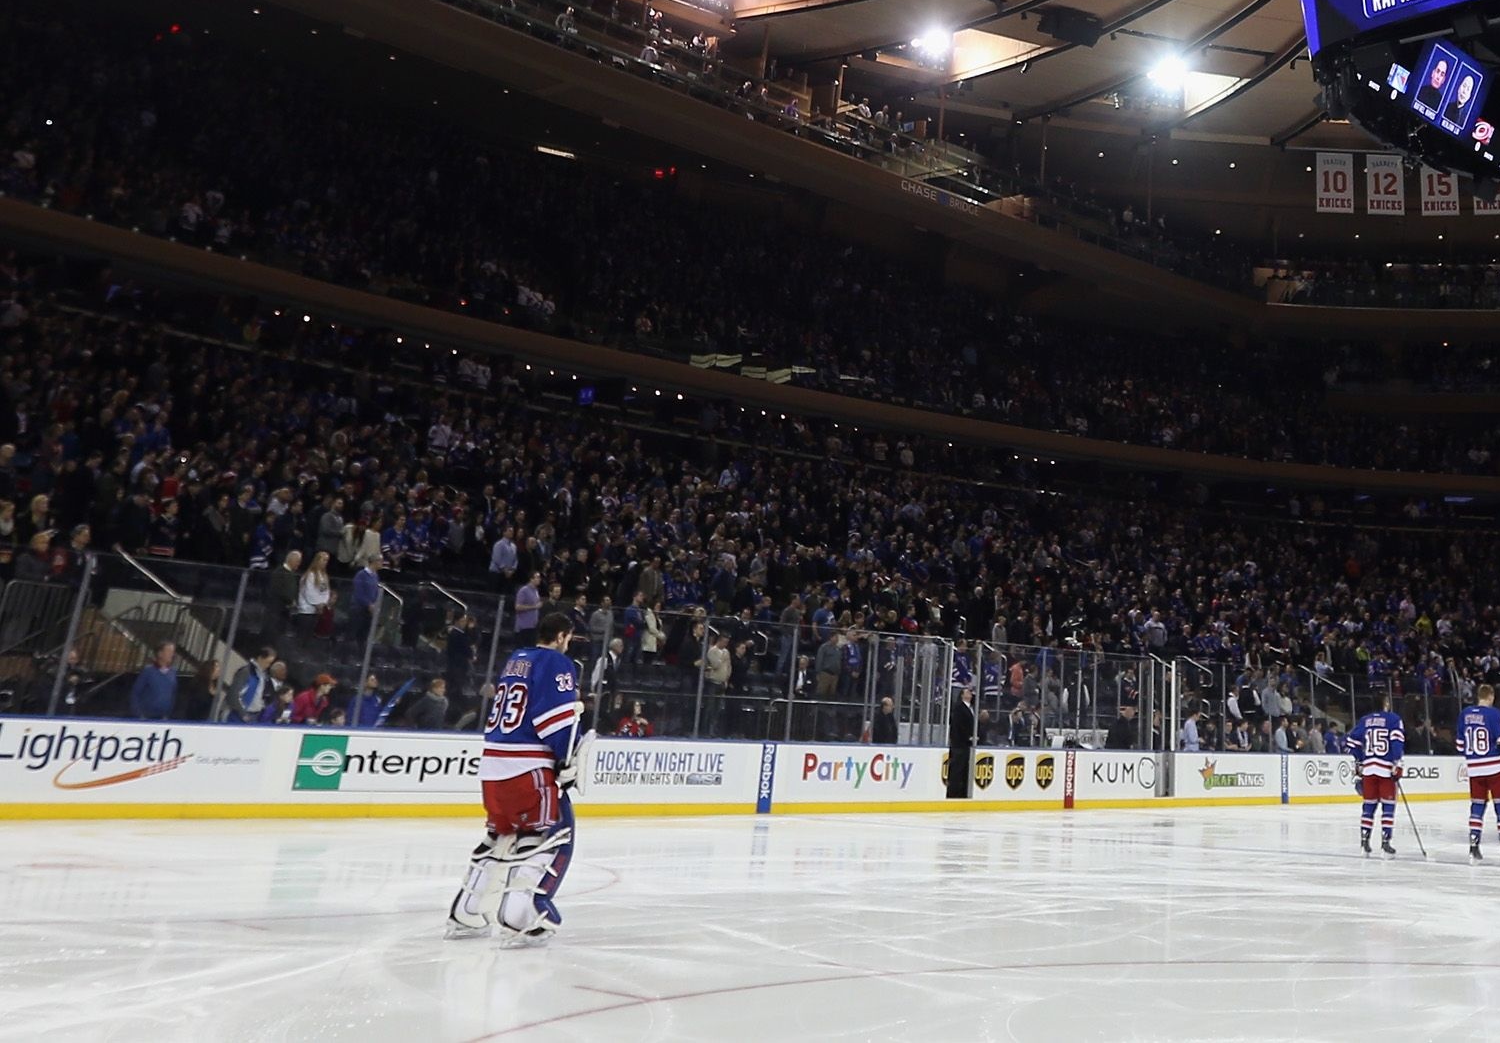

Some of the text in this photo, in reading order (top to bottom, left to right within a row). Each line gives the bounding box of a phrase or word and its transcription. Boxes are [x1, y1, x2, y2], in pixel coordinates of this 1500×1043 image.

[901, 179, 937, 201] CHASE
[1322, 170, 1347, 193] 10
[1372, 172, 1397, 196] 12
[1427, 173, 1452, 196] 15
[1319, 197, 1352, 208] KNICKS
[1369, 200, 1402, 211] KNICKS
[1423, 200, 1457, 211] KNICKS
[555, 672, 574, 692] 33
[484, 682, 529, 734] 33
[0, 722, 182, 772] Lightpath
[1365, 728, 1390, 757] 15
[1464, 726, 1490, 756] 18
[297, 749, 481, 783] enterpris
[595, 751, 725, 773] HOCKEY NIGHT LIVE
[759, 743, 775, 800] Reebok
[1401, 767, 1439, 779] LEXUS
[593, 772, 638, 785] SATURDAY
[640, 773, 671, 785] NIGHTS
[672, 773, 685, 785] ON
[974, 764, 994, 785] ups
[1006, 764, 1025, 785] ups
[1036, 764, 1054, 785] ups
